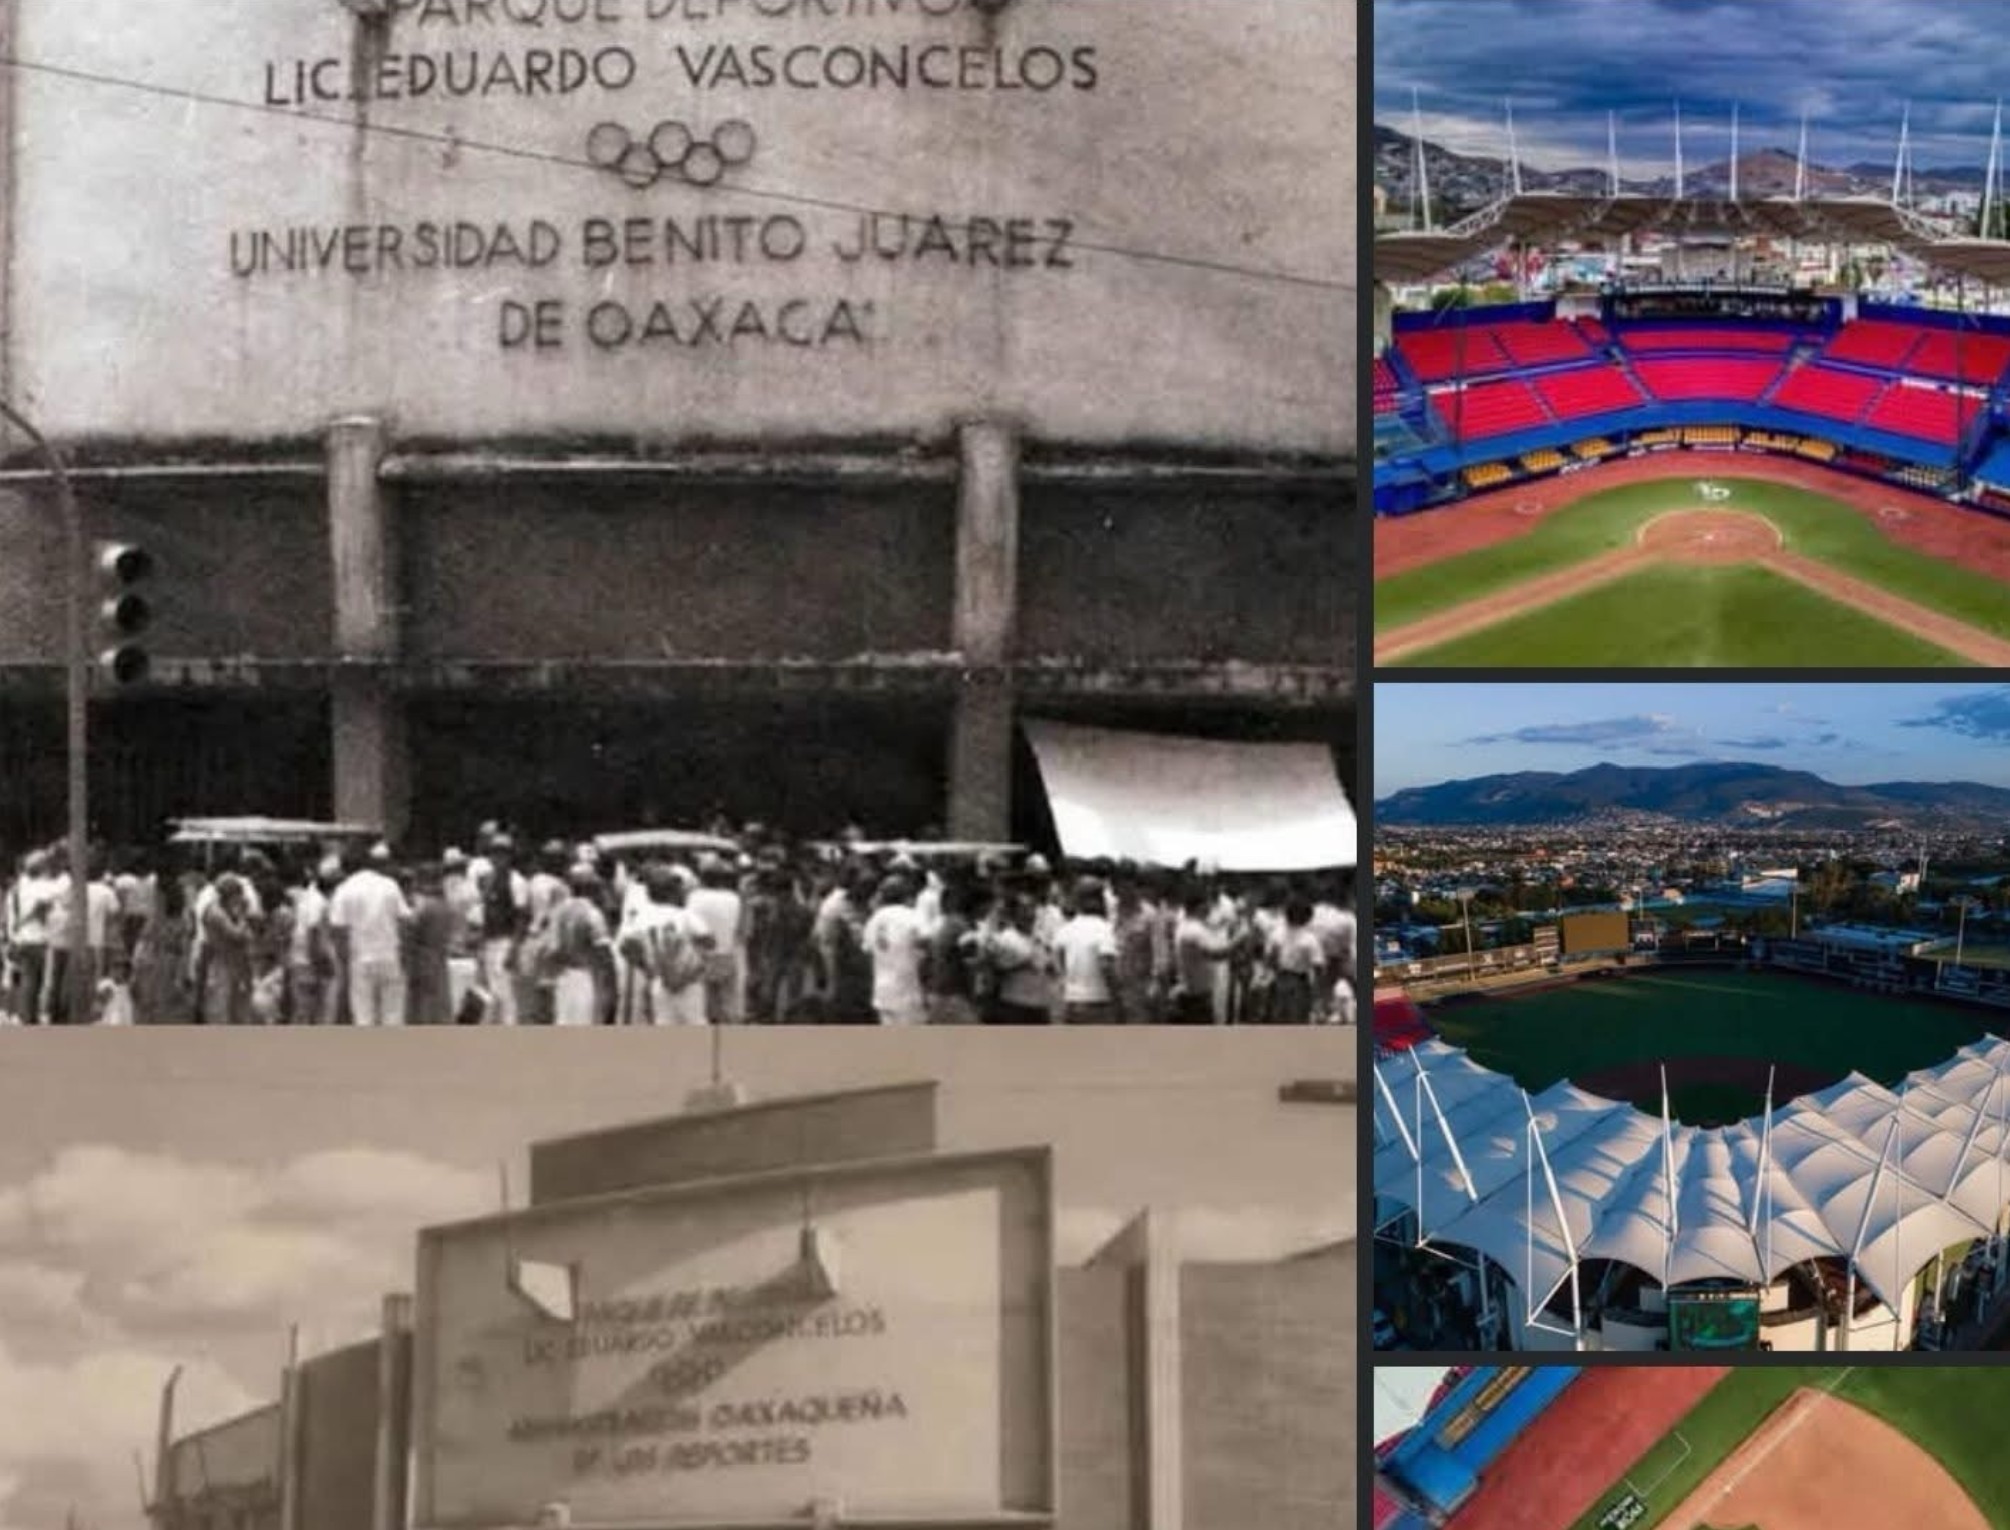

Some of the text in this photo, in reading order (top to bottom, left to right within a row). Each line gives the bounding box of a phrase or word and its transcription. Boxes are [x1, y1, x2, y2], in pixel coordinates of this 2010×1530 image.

[376, 47, 636, 98] EDUARDO
[677, 45, 1098, 92] VASCONCELOS
[231, 212, 1075, 277] UNIVERSIDAD BENITO JUAREZ
[500, 301, 562, 348] DE
